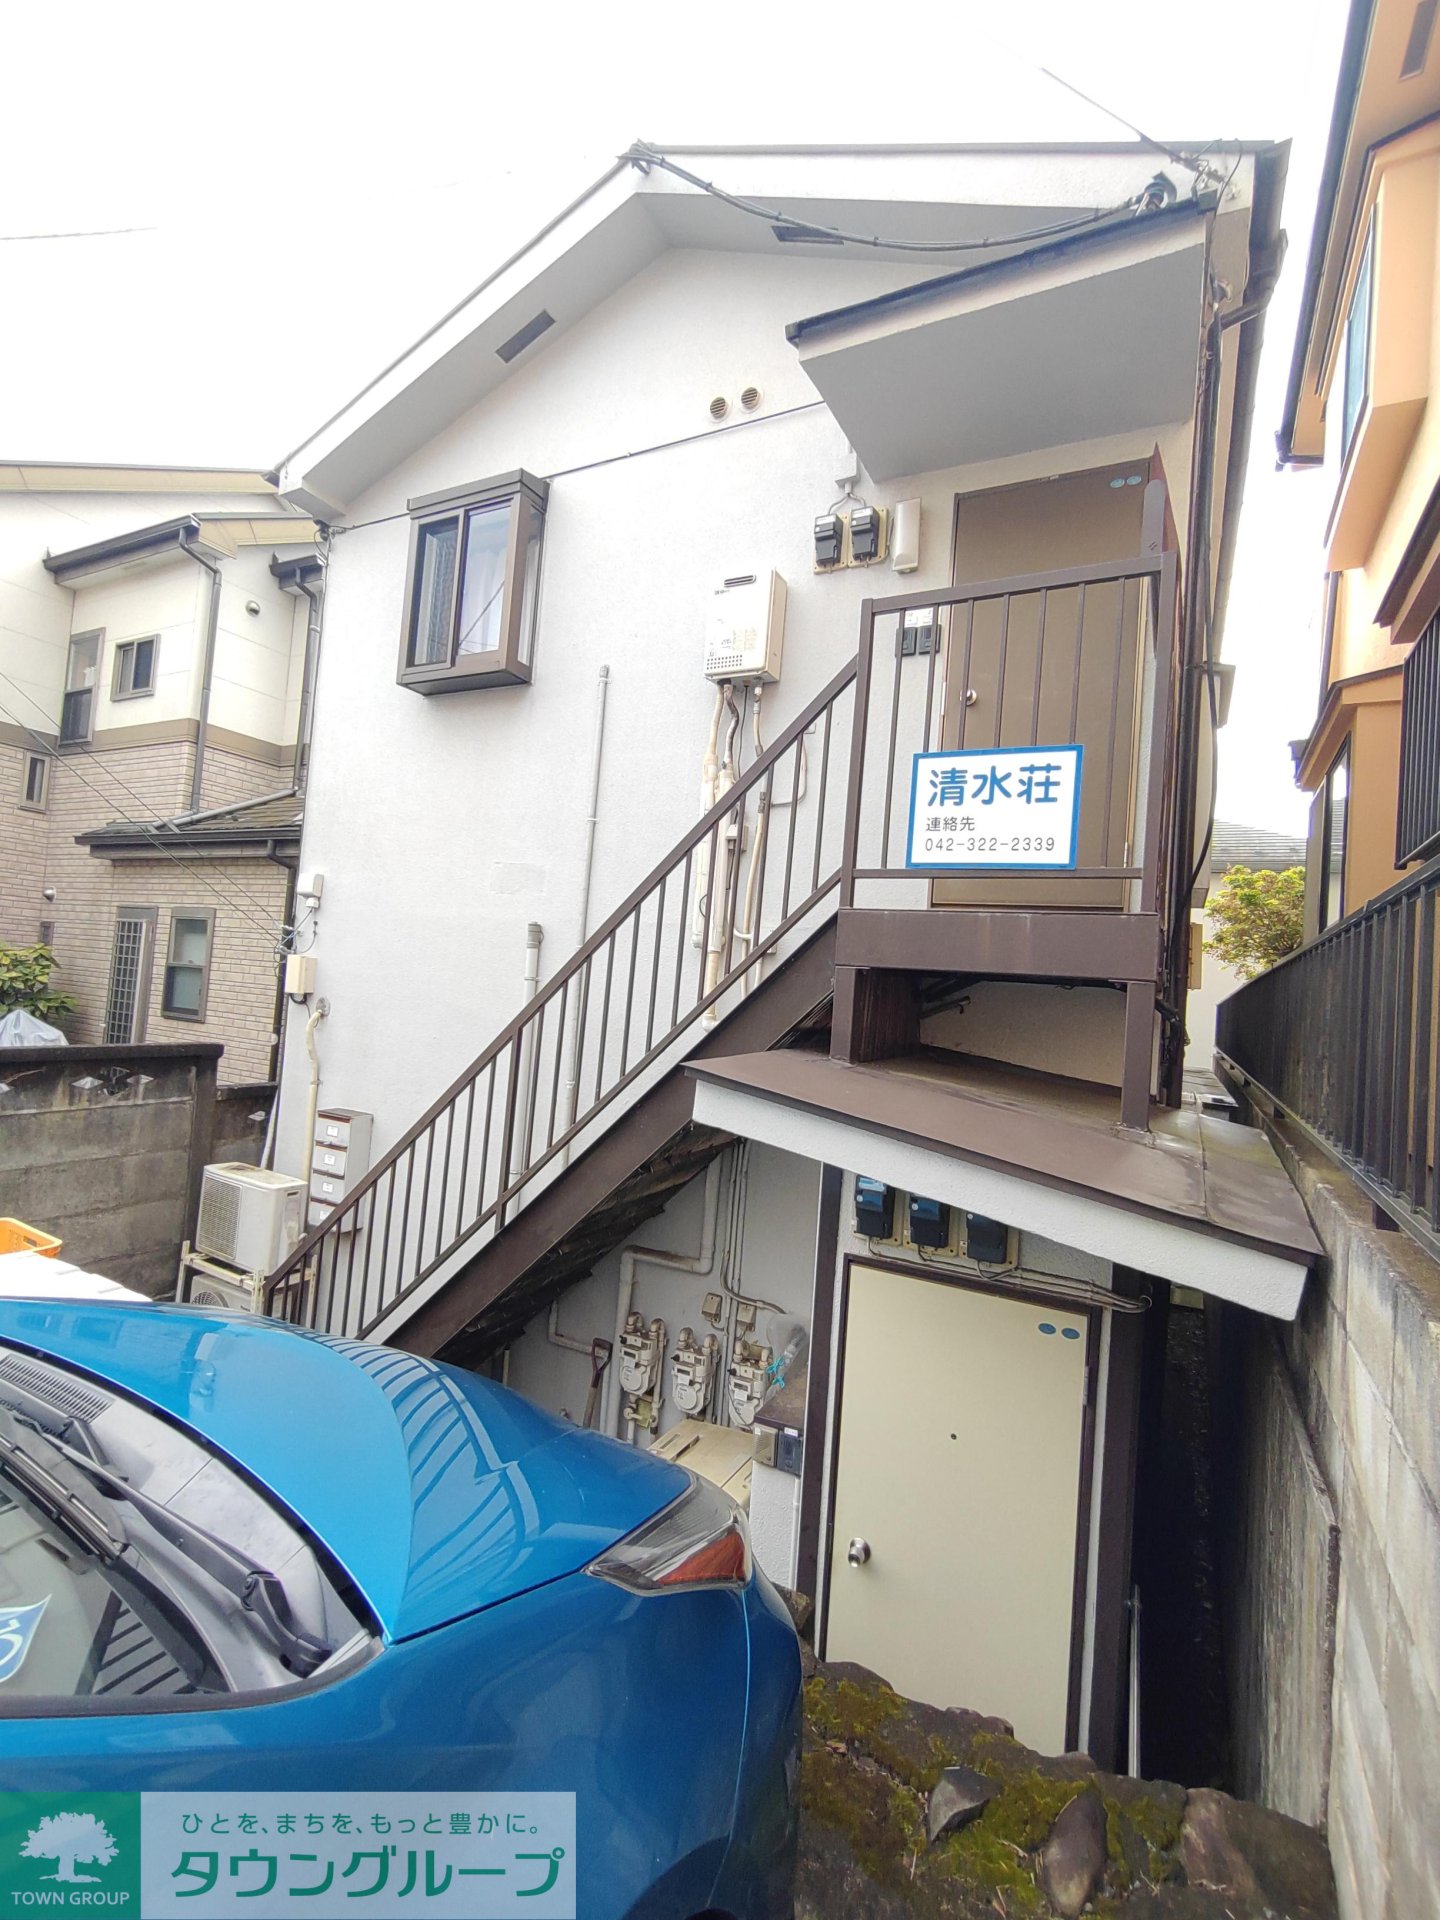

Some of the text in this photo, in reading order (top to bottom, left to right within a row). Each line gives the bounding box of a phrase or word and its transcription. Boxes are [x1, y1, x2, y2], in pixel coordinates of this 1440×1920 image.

[928, 763, 1062, 807] 清水荘
[925, 816, 975, 832] 連絡先
[925, 837, 1055, 851] 042-322-2339
